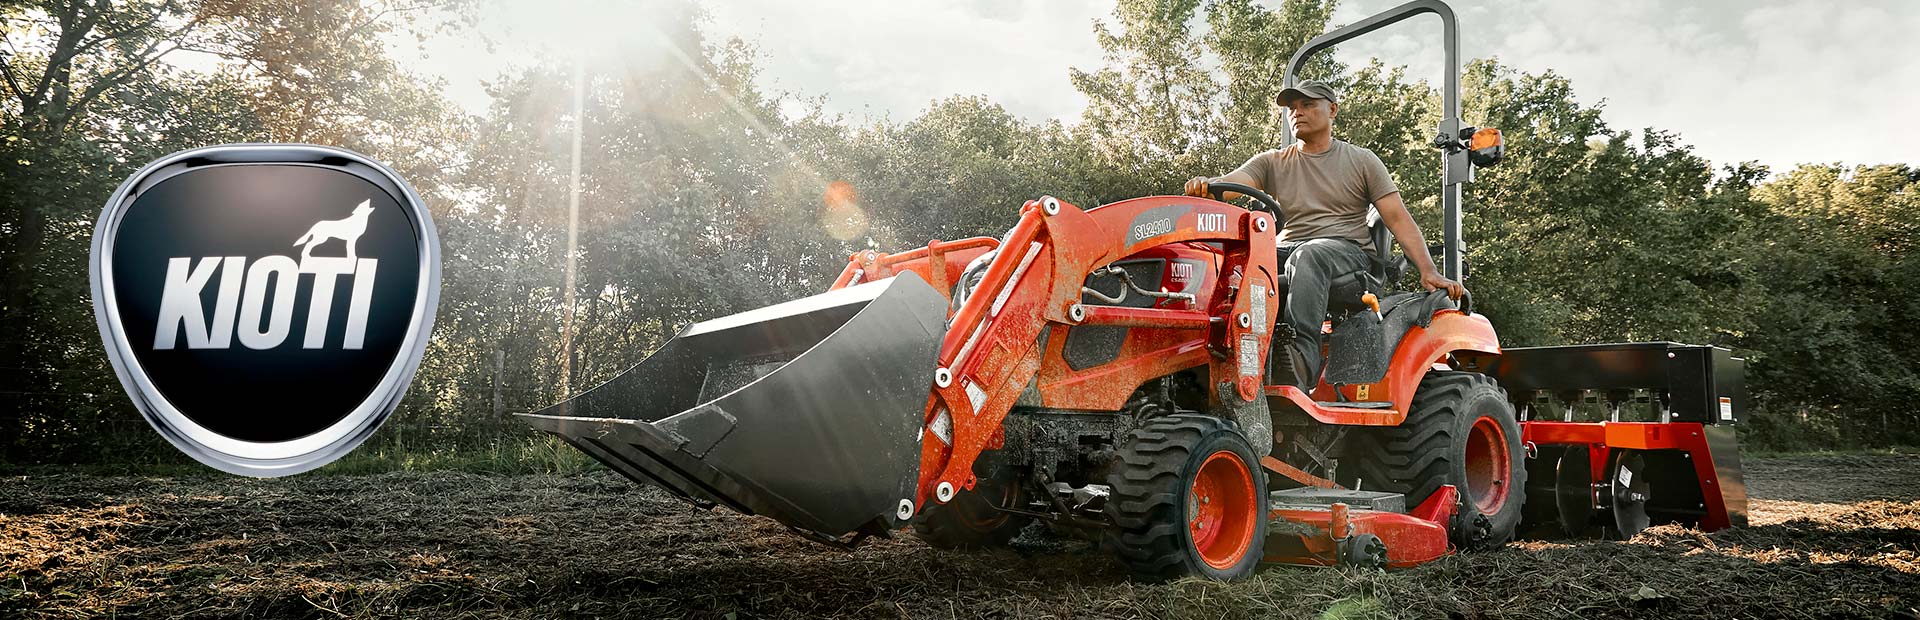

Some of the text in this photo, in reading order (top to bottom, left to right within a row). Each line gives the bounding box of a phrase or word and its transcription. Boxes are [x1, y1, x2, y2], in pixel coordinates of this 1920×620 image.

[1134, 218, 1171, 240] SL2410
[1197, 213, 1226, 232] KIOTI
[1171, 262, 1193, 278] KIOTI
